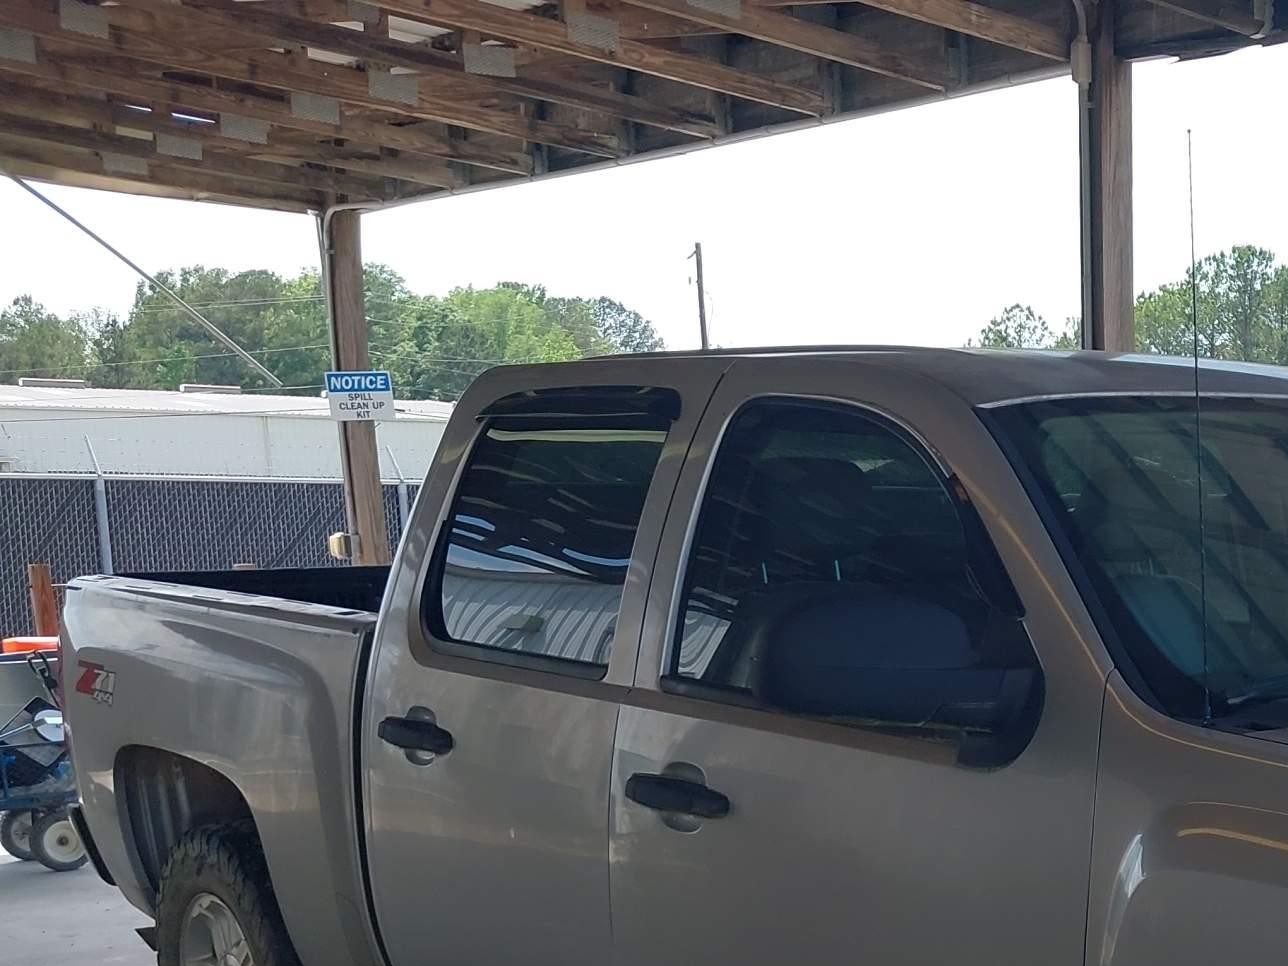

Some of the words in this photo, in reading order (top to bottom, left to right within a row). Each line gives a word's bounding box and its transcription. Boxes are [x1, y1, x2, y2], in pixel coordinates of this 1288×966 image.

[330, 375, 387, 390] NOTICE
[348, 392, 373, 401] SPILL
[339, 401, 369, 410] CLEAN
[372, 401, 385, 410] UP
[356, 410, 371, 419] KIT
[75, 659, 116, 695] Z71
